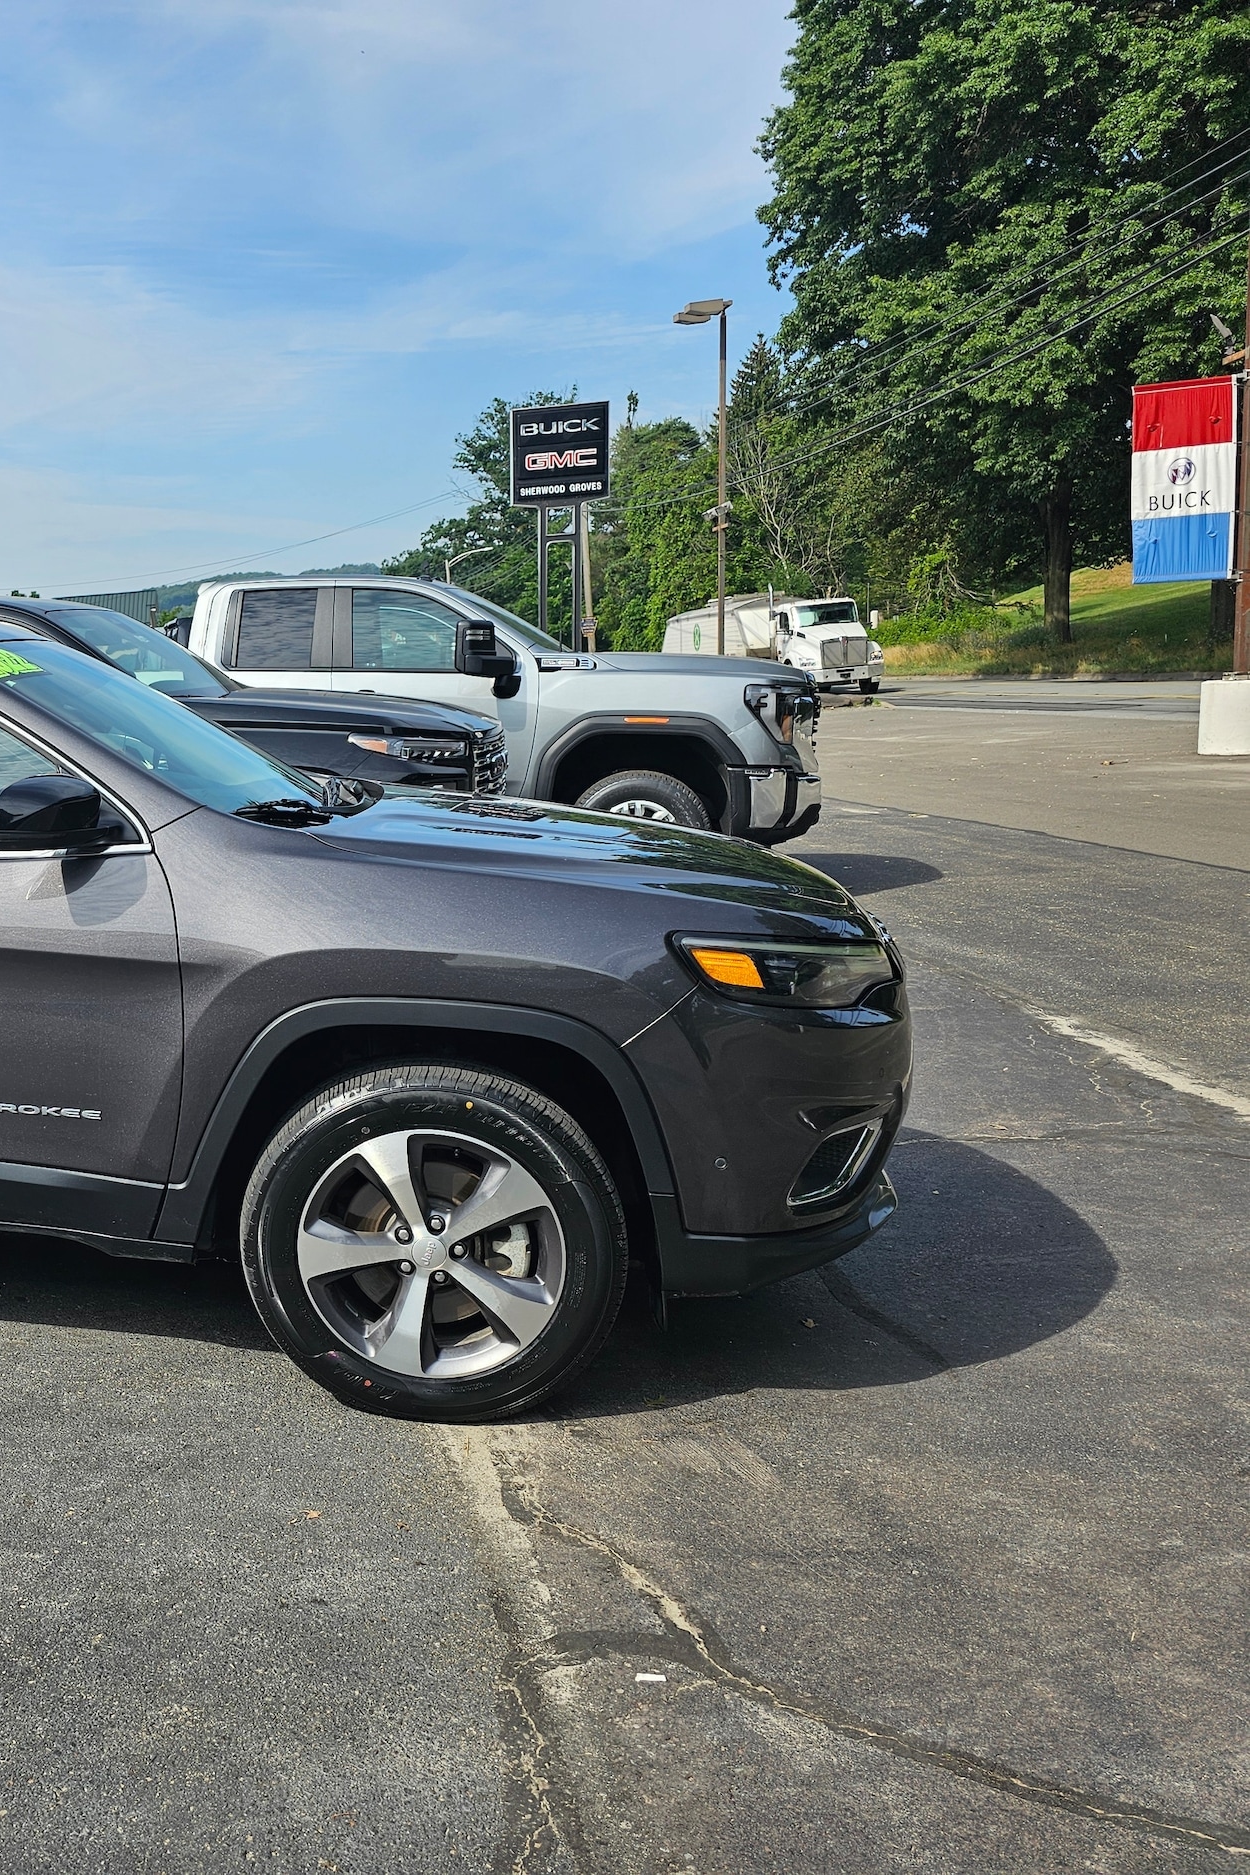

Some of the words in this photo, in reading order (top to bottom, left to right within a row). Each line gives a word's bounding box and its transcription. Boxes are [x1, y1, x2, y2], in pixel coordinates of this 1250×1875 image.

[520, 417, 601, 437] BUICK
[525, 448, 598, 472] GMC
[520, 484, 566, 497] SHERWOOD
[569, 481, 602, 493] GROVES
[1149, 490, 1212, 512] BUICK
[421, 1241, 437, 1266] Jeep
